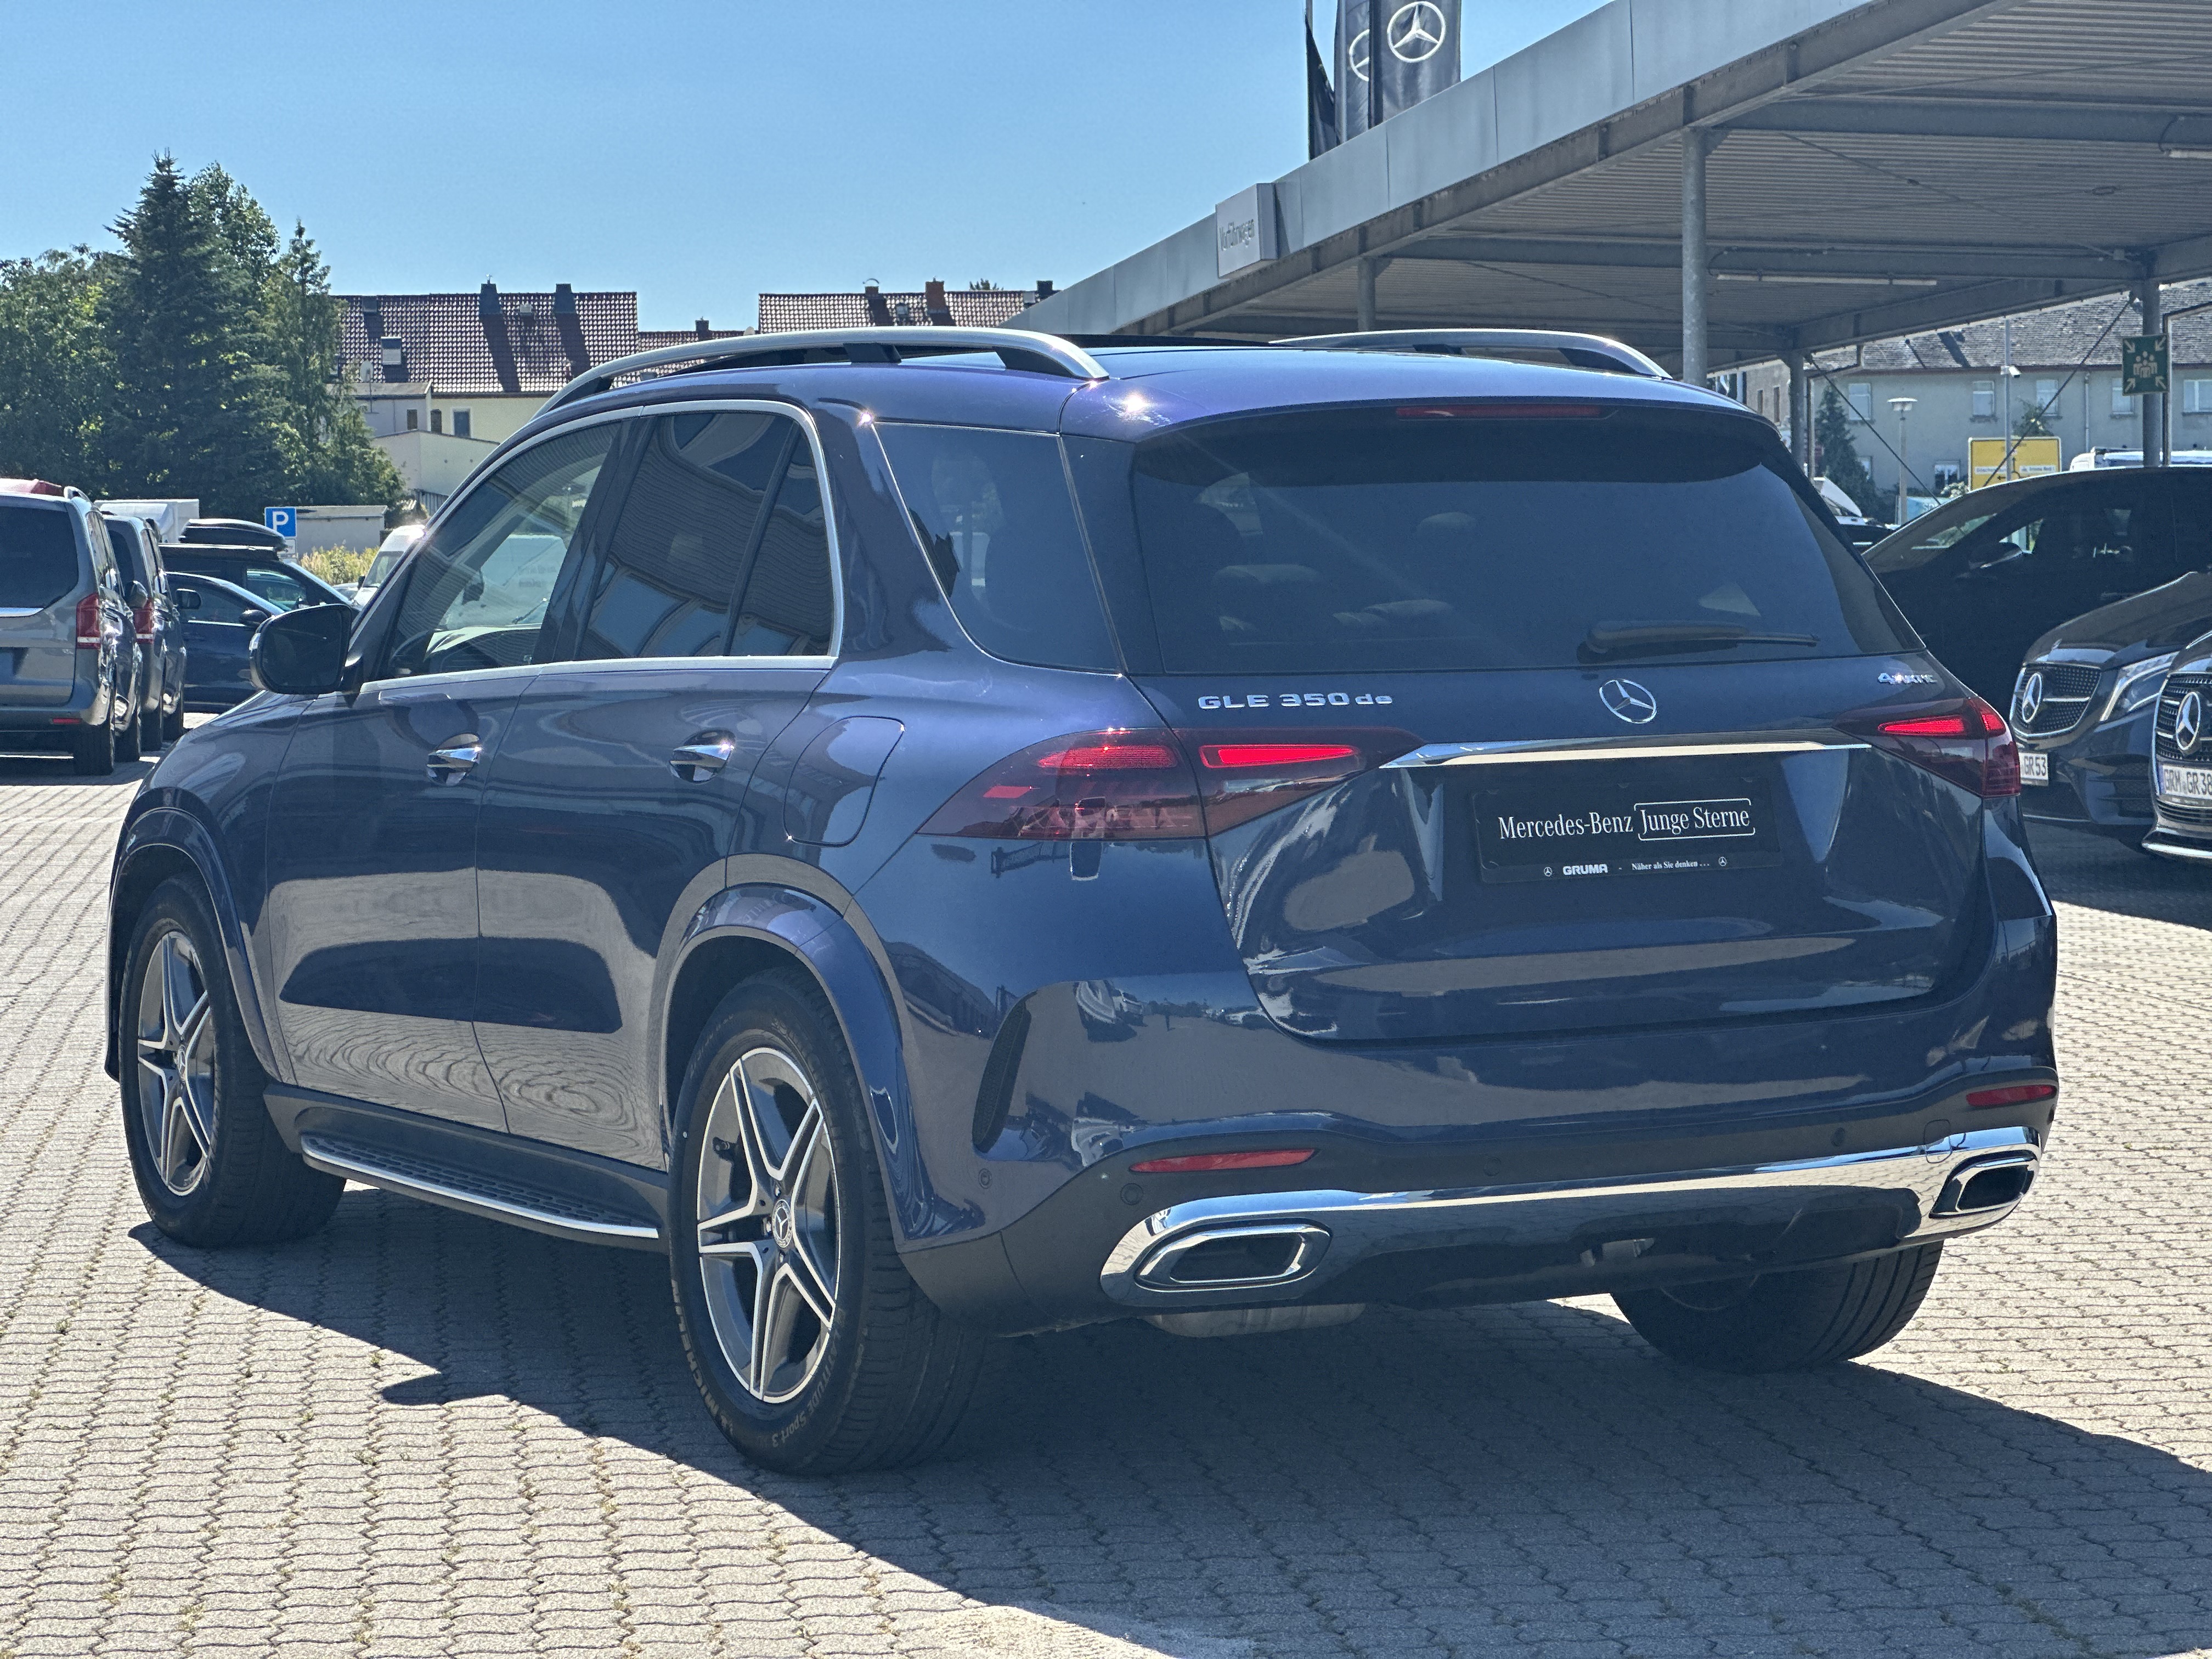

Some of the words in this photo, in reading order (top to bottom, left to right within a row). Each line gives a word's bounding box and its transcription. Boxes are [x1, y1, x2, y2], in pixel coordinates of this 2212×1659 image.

[273, 511, 289, 531] P
[1198, 694, 1270, 709] GLE
[2035, 756, 2046, 776] 53
[2186, 771, 2200, 795] GR
[1498, 811, 1633, 839] Mercedes-Benz
[1640, 809, 1690, 835] Junge
[1693, 806, 1750, 830] Sterne
[1562, 864, 1608, 876] GRUMA
[1632, 862, 1652, 871] Näher
[1653, 861, 1663, 870] als
[1663, 861, 1673, 869] Sie
[780, 1410, 807, 1444] Sport
[771, 1433, 778, 1448] 3
